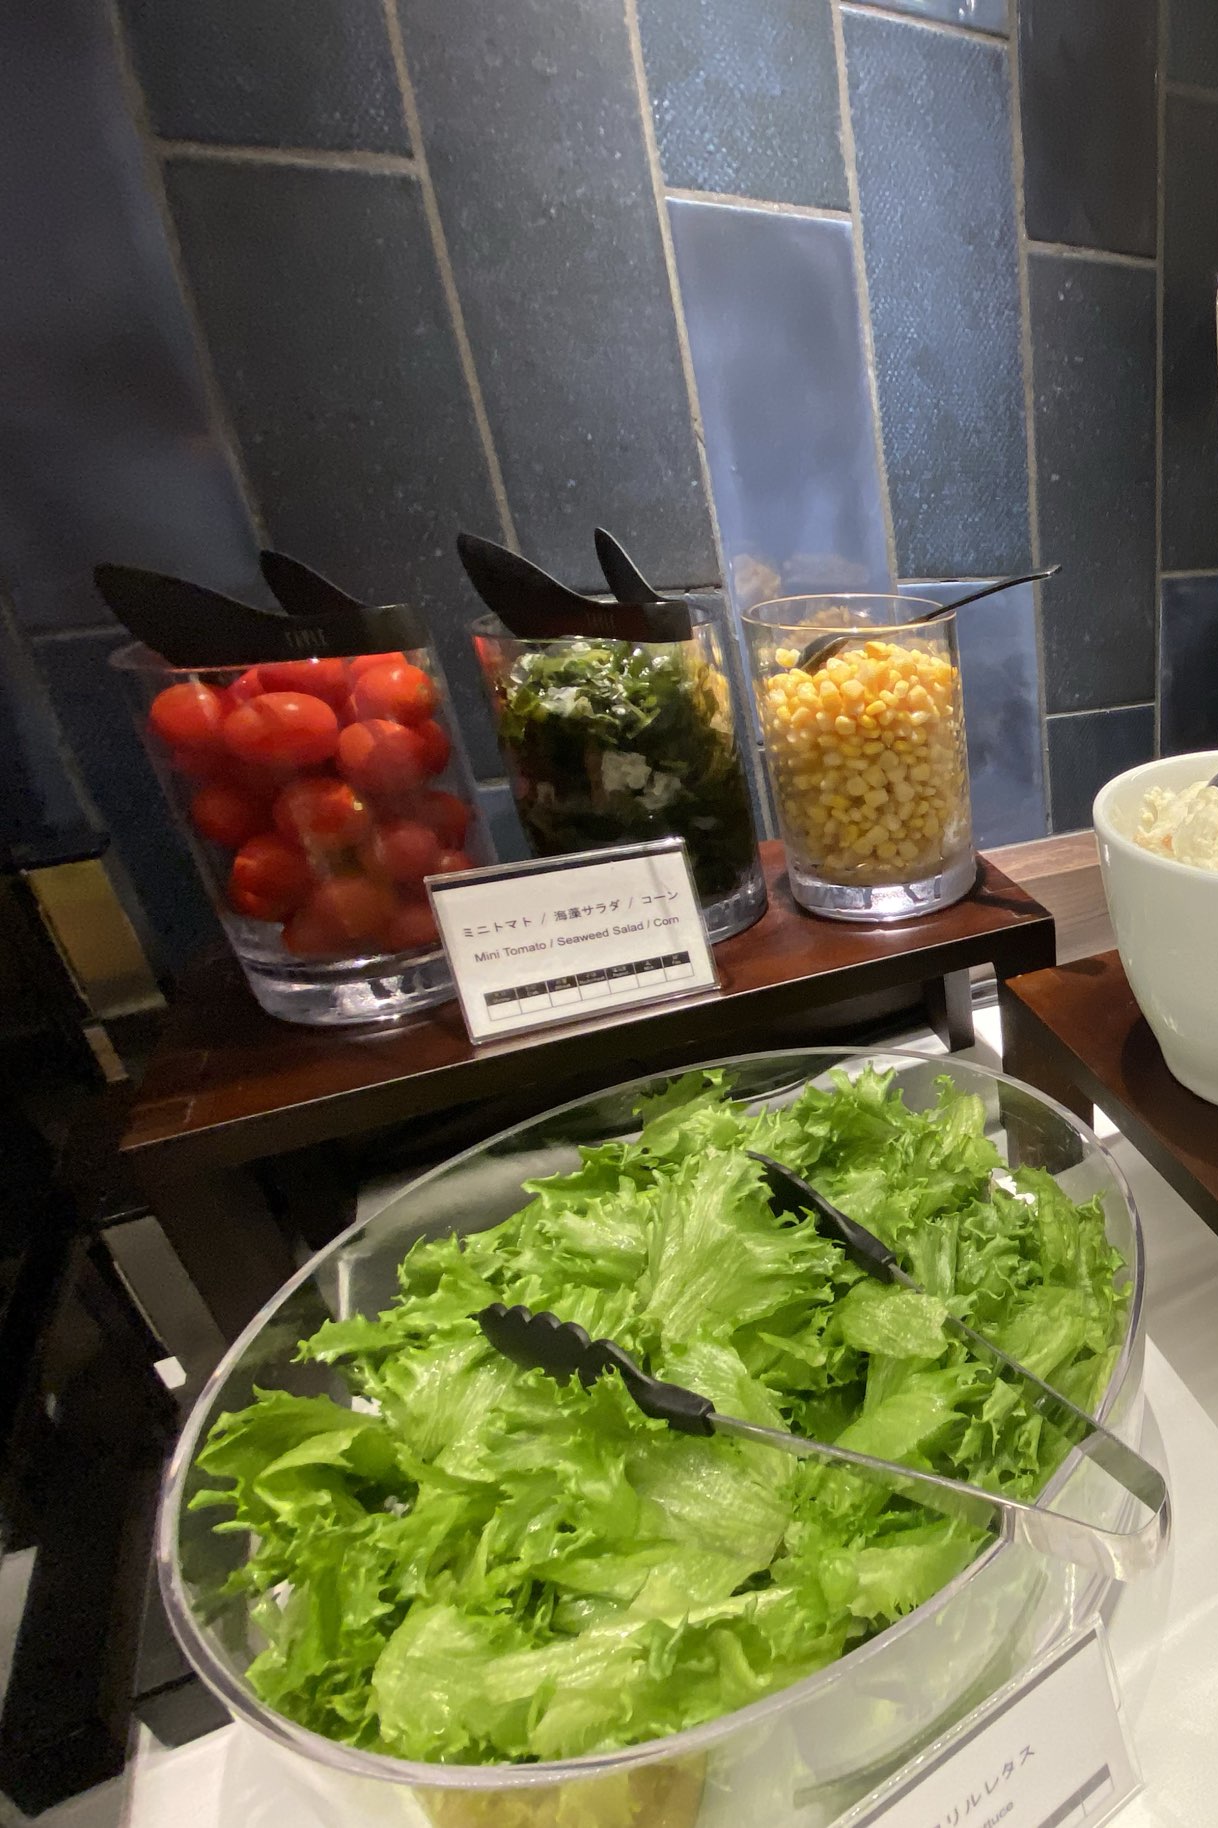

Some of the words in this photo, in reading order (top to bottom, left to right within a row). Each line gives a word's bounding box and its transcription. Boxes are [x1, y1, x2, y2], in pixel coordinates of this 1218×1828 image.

[463, 916, 532, 938] ミニトマト
[554, 899, 620, 922] 海藻サラダ
[641, 891, 679, 905] コーン
[474, 950, 500, 963] Mini
[502, 942, 547, 957] Tomato
[557, 928, 610, 947] Seaweed
[612, 921, 644, 936] Salad
[653, 915, 680, 928] Corn
[934, 1744, 1035, 1828] リルレタス
[983, 1800, 1014, 1828] ttuce
